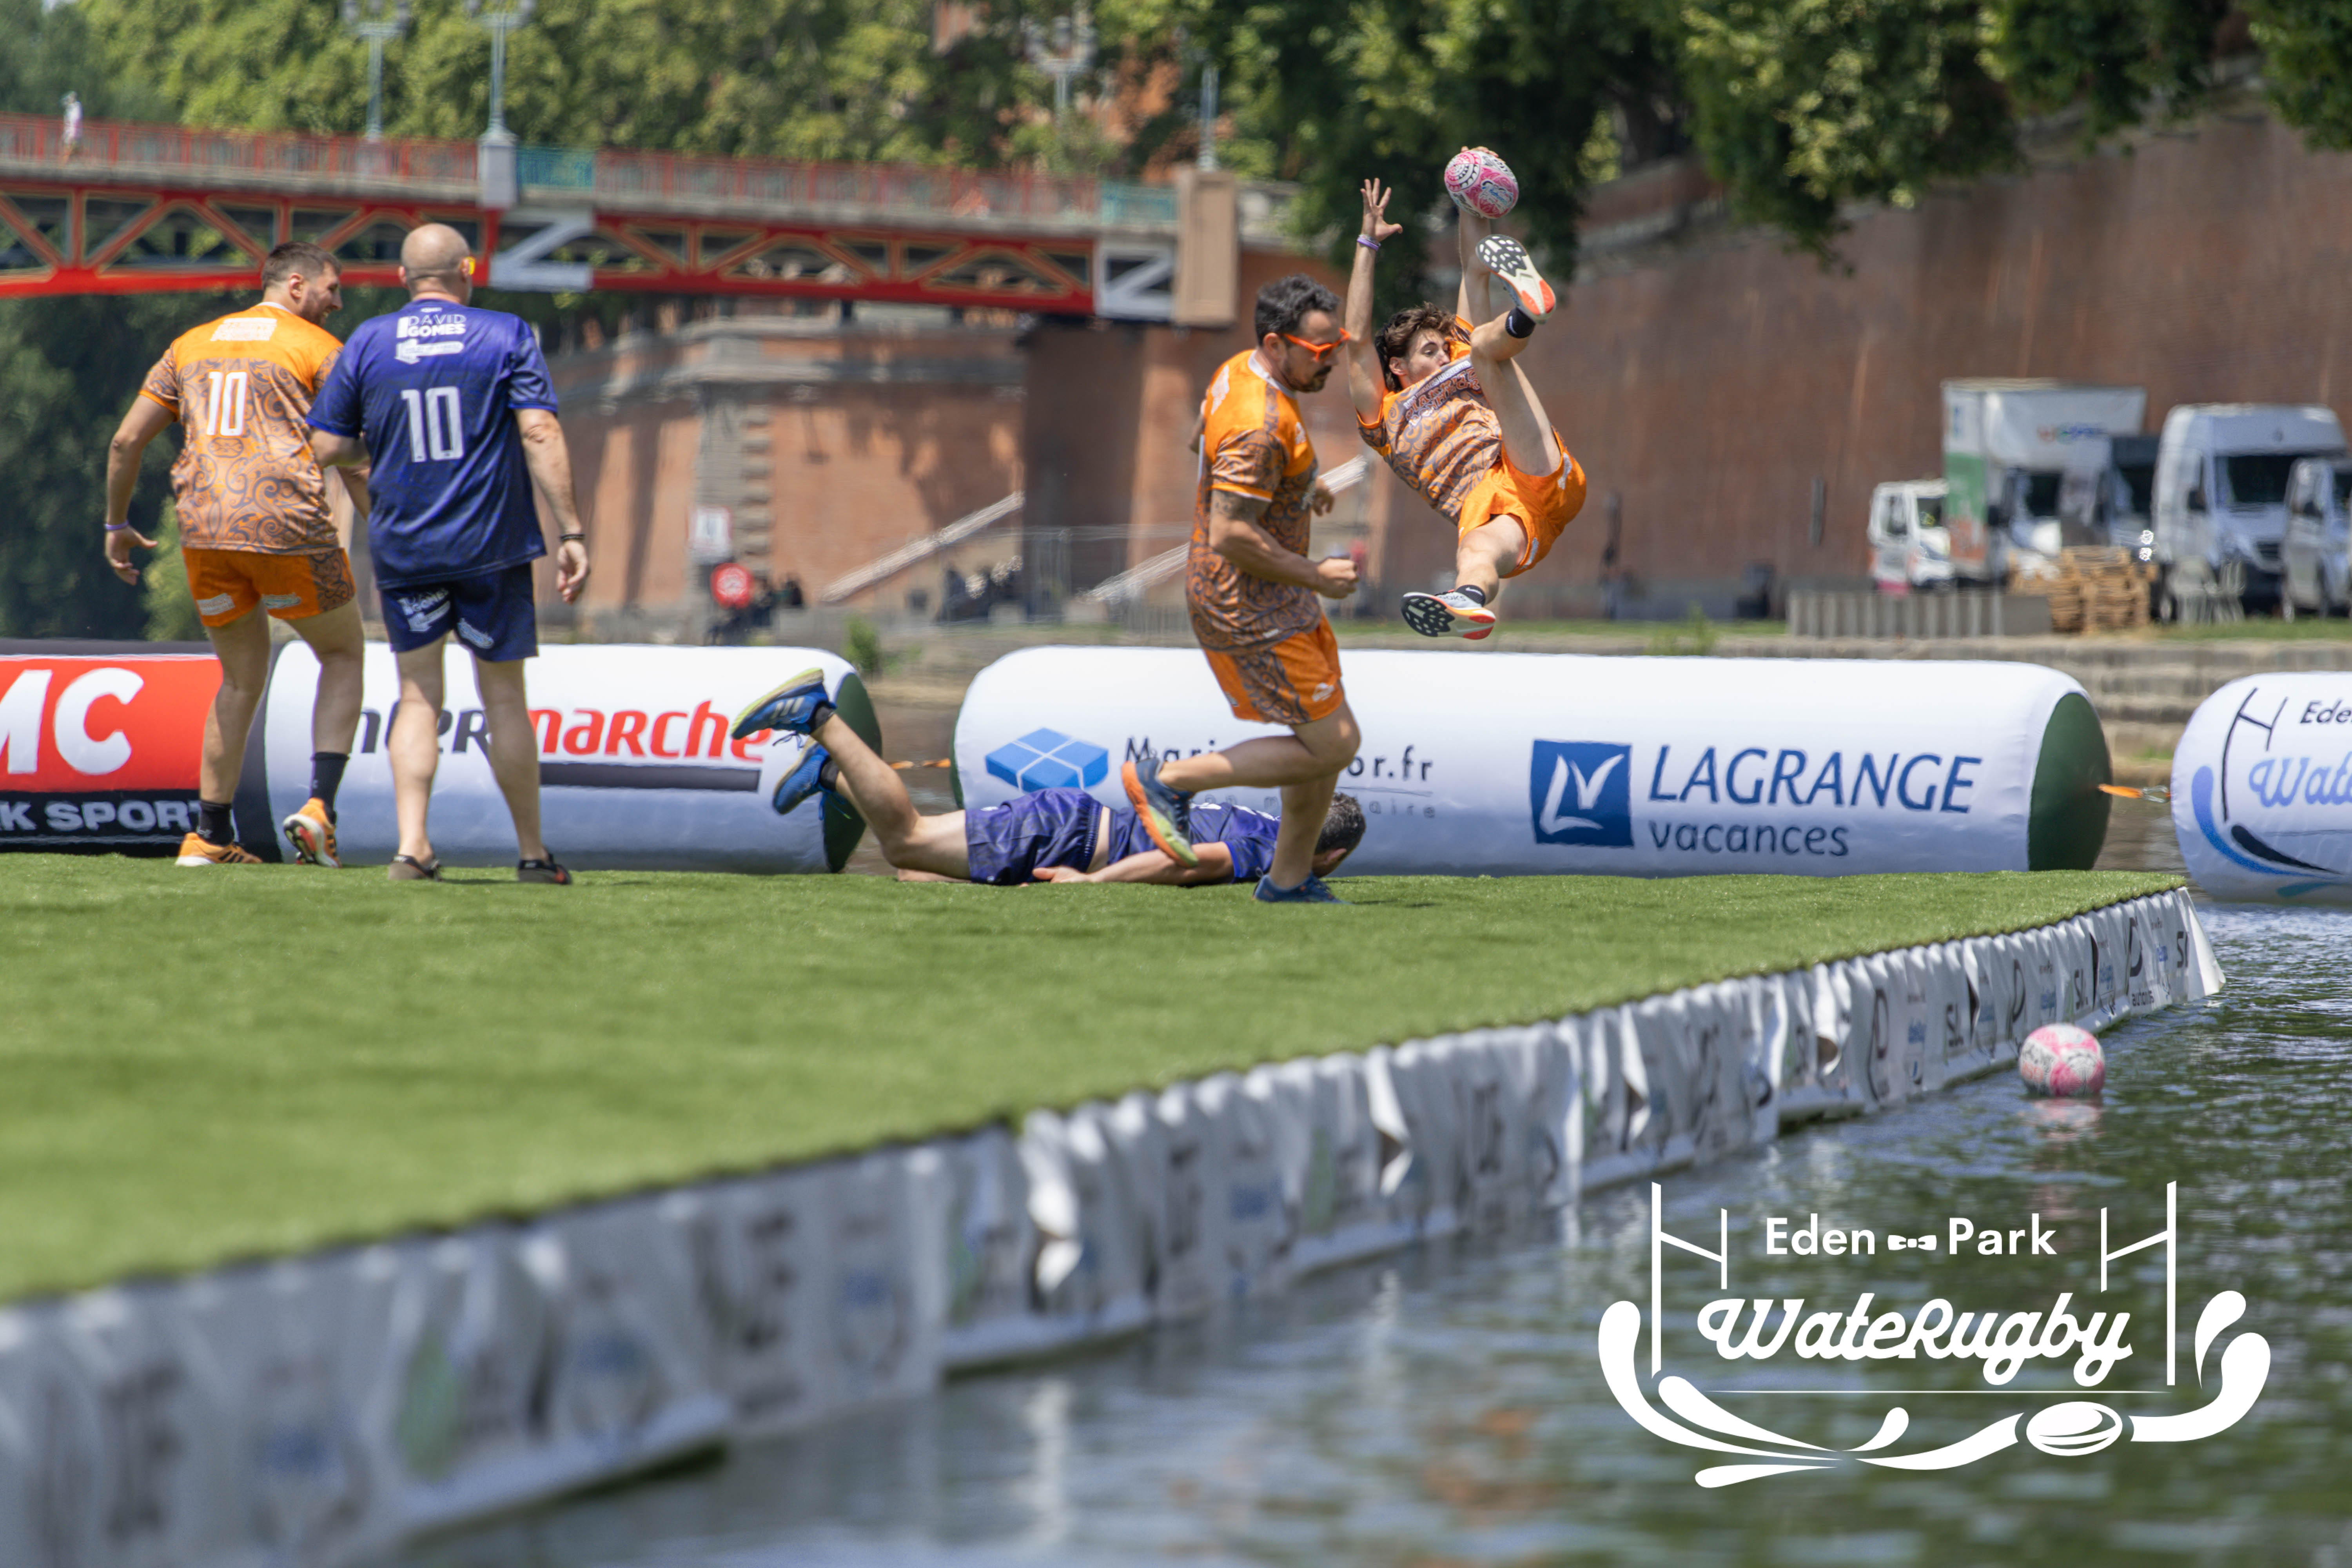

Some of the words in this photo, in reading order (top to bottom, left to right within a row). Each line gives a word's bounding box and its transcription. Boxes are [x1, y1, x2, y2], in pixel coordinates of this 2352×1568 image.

[408, 314, 466, 326] DAVID
[408, 323, 466, 337] GOMES
[206, 371, 248, 437] 10
[401, 386, 464, 463] 10
[2299, 699, 2352, 725] Ede
[1648, 745, 1983, 815] LAGRANGE
[1649, 820, 1849, 857] vacances
